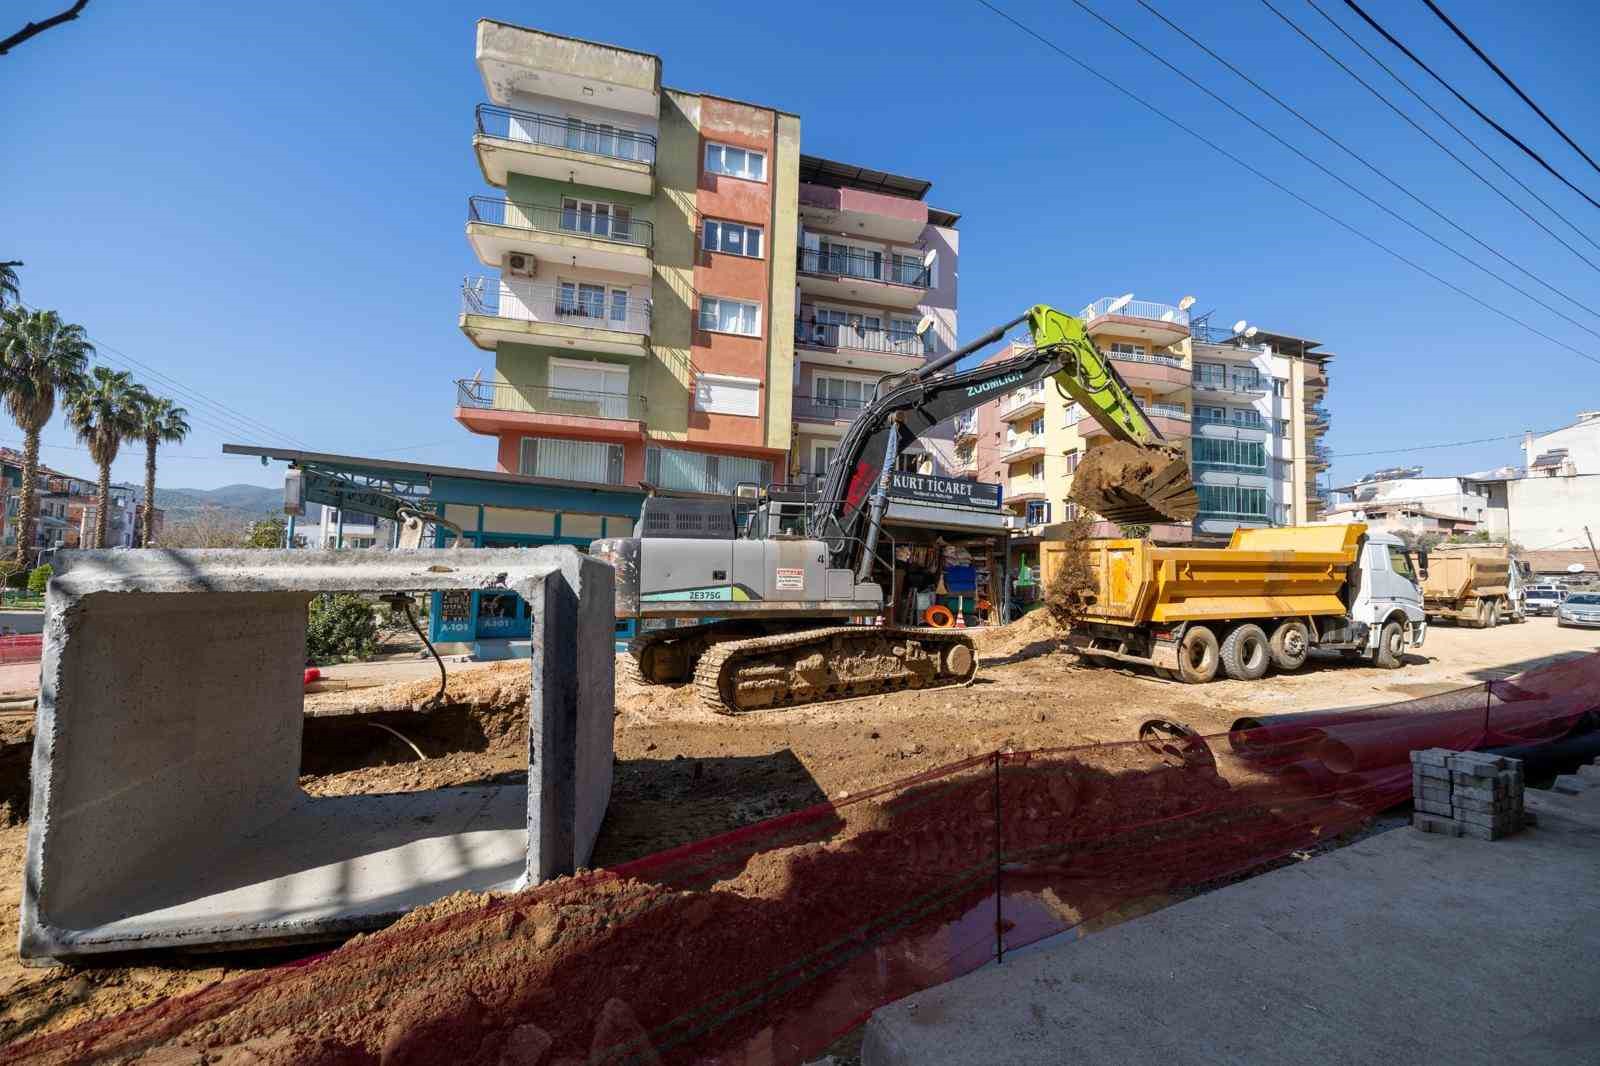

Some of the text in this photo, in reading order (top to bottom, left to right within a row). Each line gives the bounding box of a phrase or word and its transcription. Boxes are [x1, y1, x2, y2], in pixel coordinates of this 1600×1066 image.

[966, 371, 1024, 397] ZOOMLION
[893, 474, 923, 490] KURT
[927, 477, 973, 496] TİCARET
[690, 591, 721, 600] ZE375G
